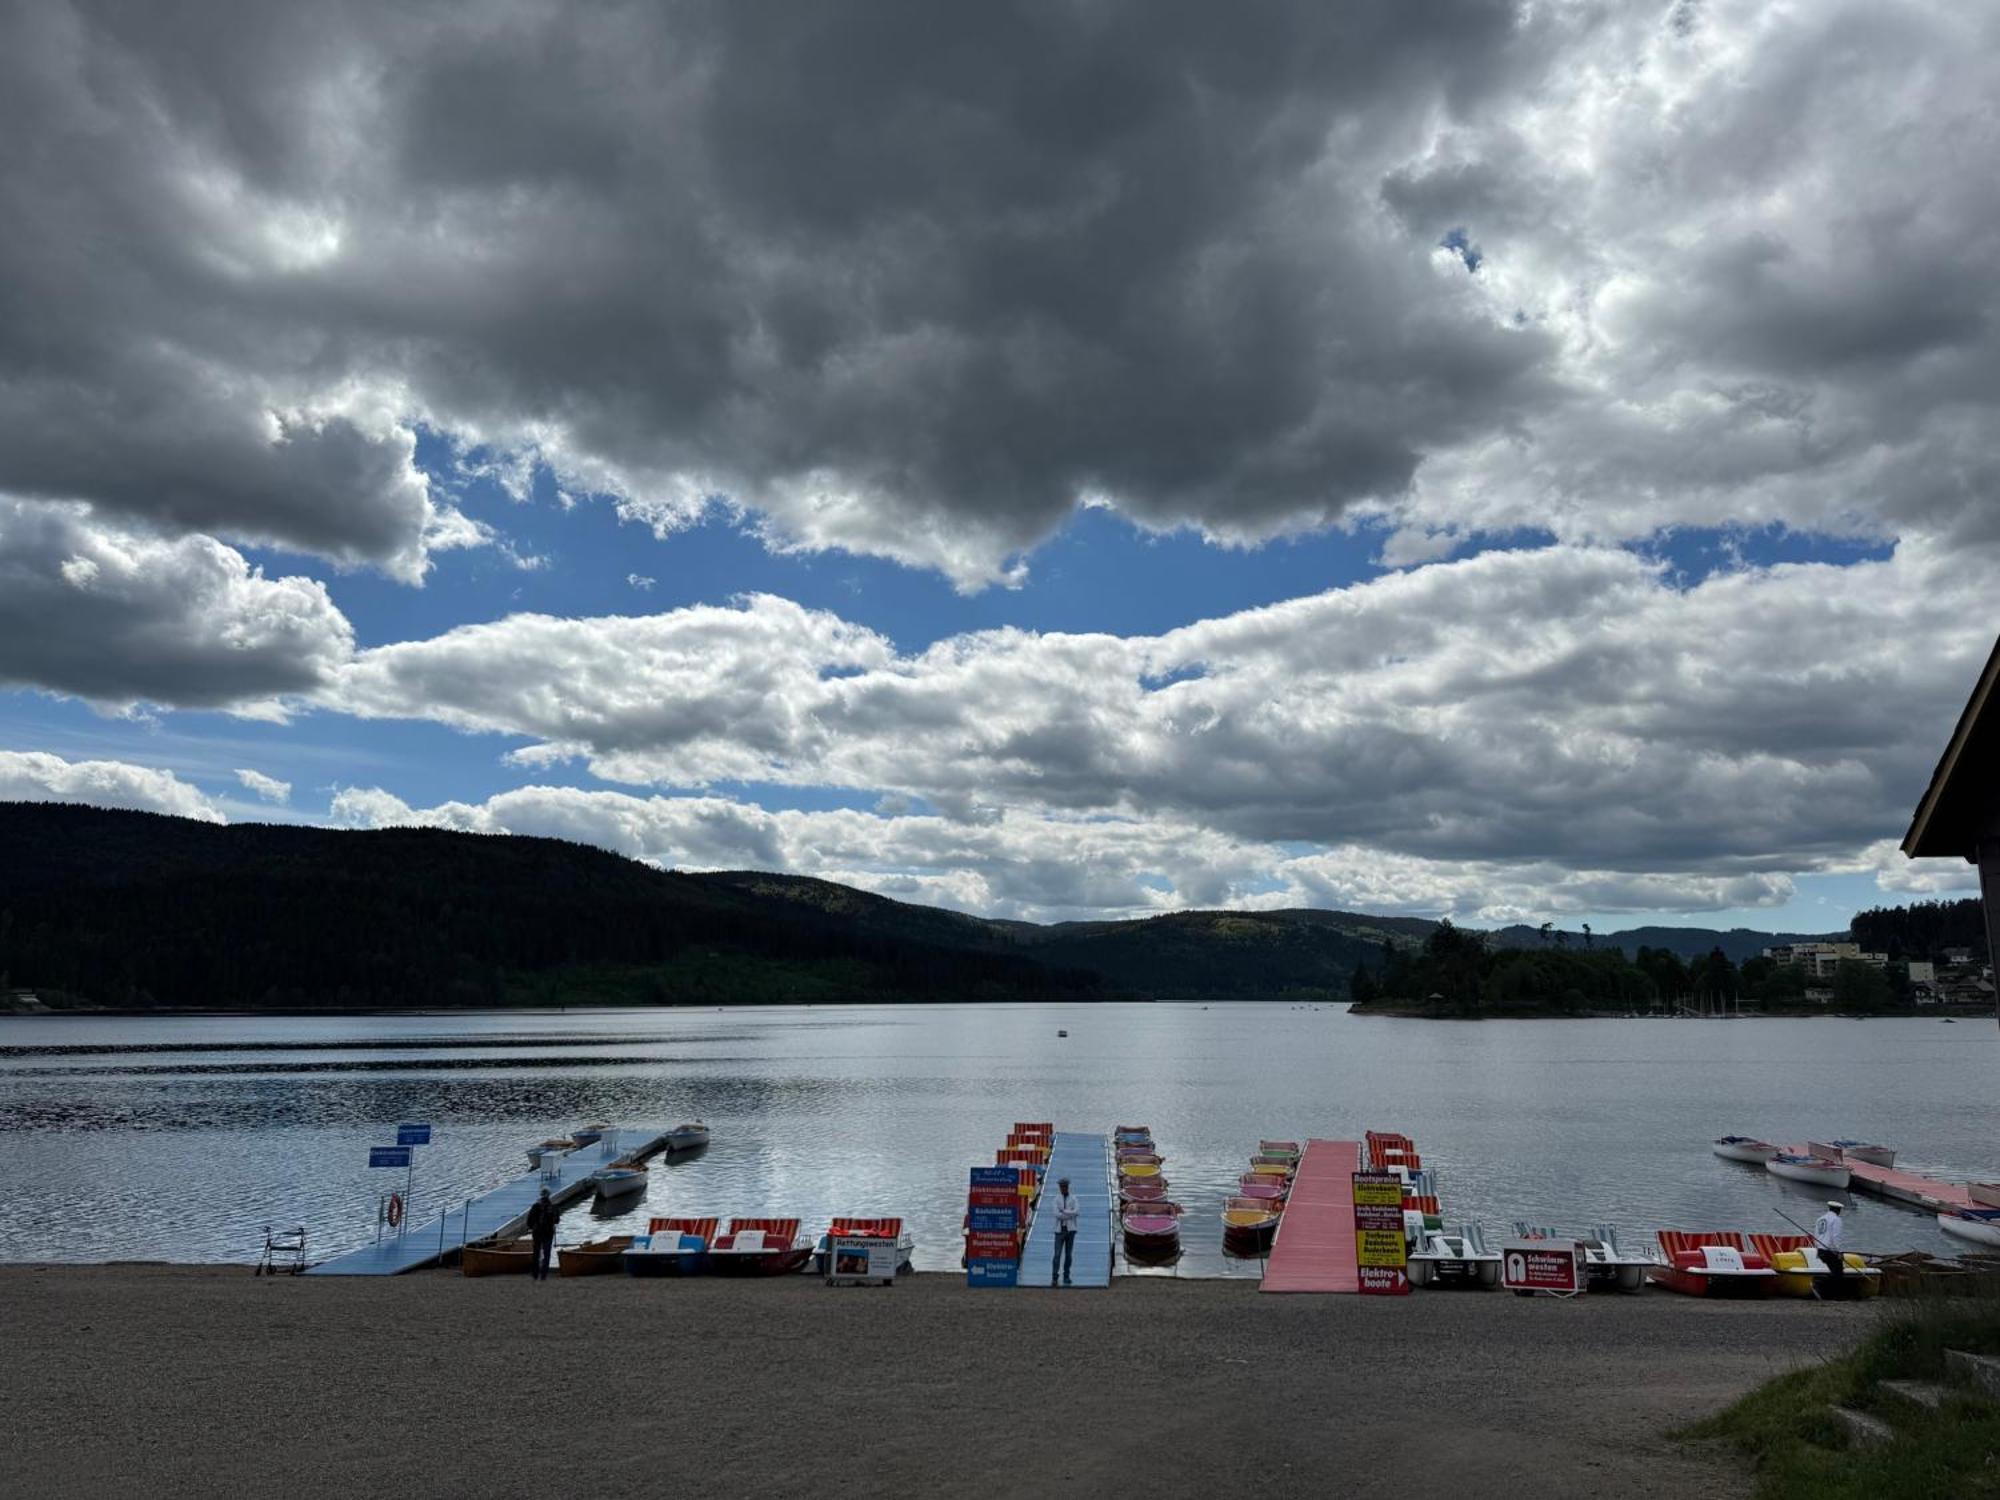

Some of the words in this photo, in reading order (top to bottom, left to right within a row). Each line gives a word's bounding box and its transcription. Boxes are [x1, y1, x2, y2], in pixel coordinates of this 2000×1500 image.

[1355, 1174, 1400, 1184] Bootspreise
[837, 1239, 894, 1248] Rettungswesten
[1527, 1254, 1568, 1264] Schwimm-
[1361, 1267, 1397, 1277] Elektro-
[1528, 1264, 1557, 1272] westen
[1364, 1277, 1391, 1288] boote
